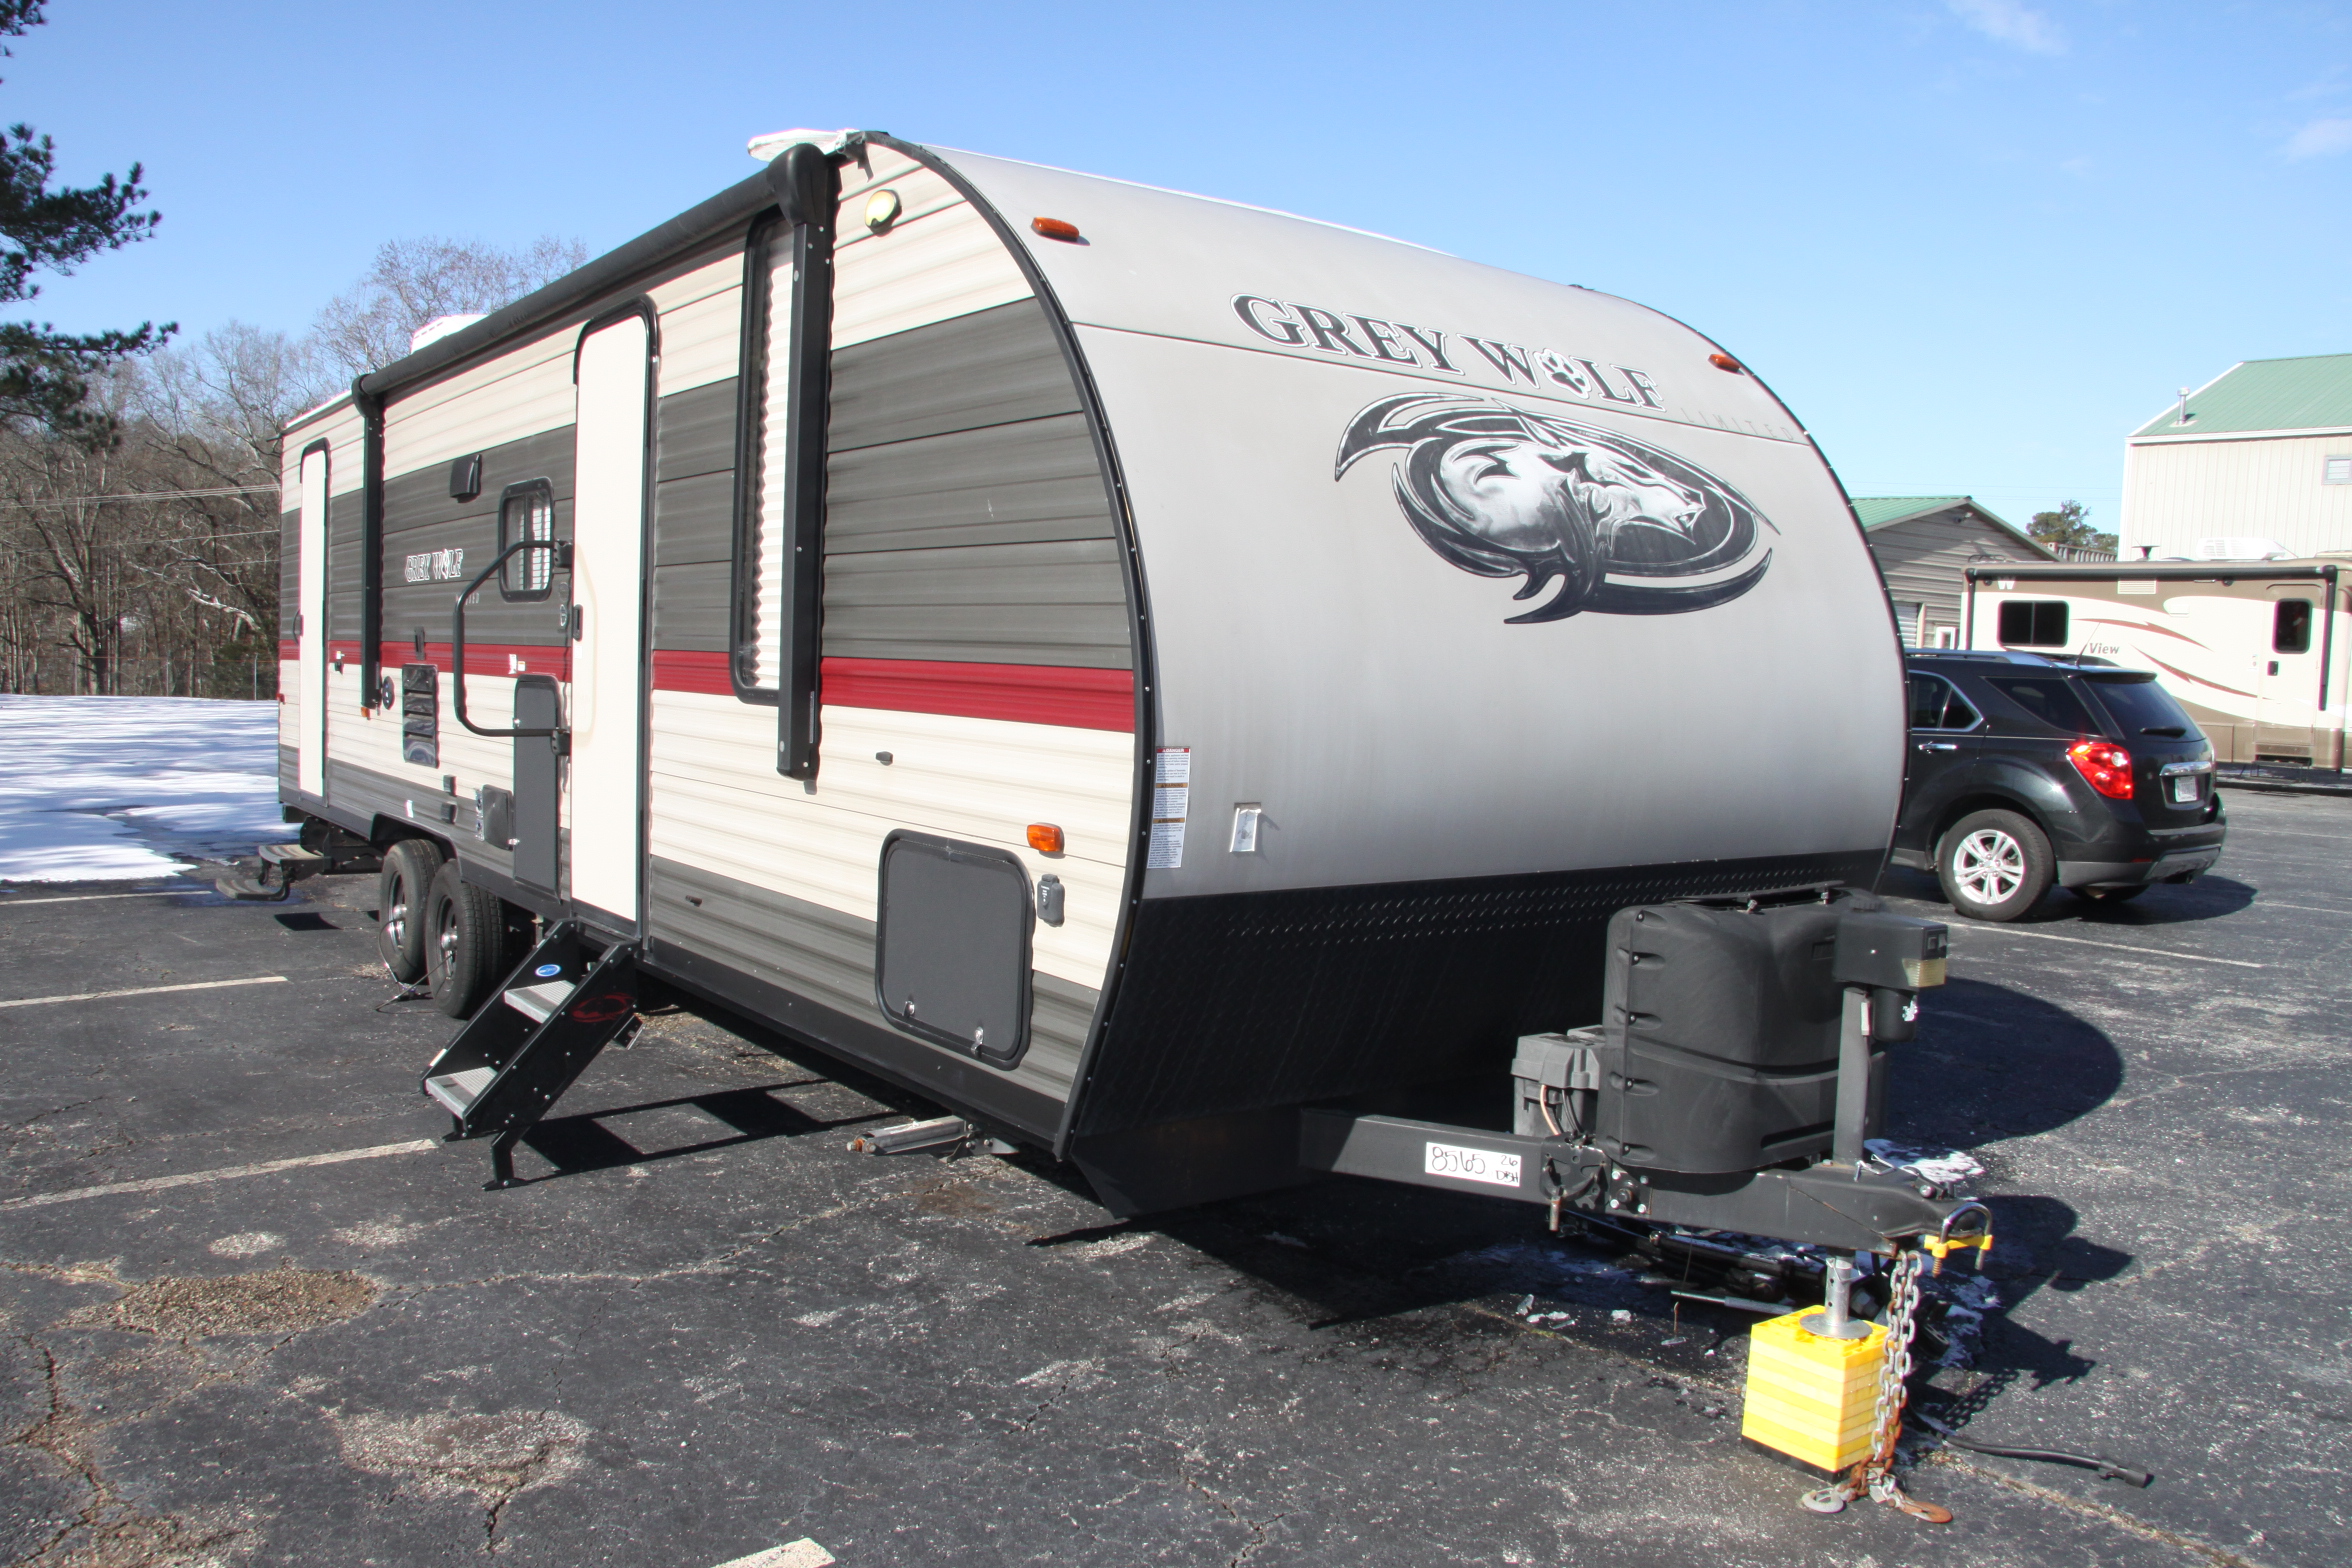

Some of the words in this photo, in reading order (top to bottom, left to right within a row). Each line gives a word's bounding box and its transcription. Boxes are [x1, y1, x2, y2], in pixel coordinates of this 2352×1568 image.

[1230, 293, 1466, 377] GREY
[1680, 407, 1794, 440] LIMITED
[405, 553, 431, 582] GREY
[2090, 642, 2120, 655] View
[1431, 1146, 1486, 1175] 8565
[1501, 1154, 1518, 1167] 26
